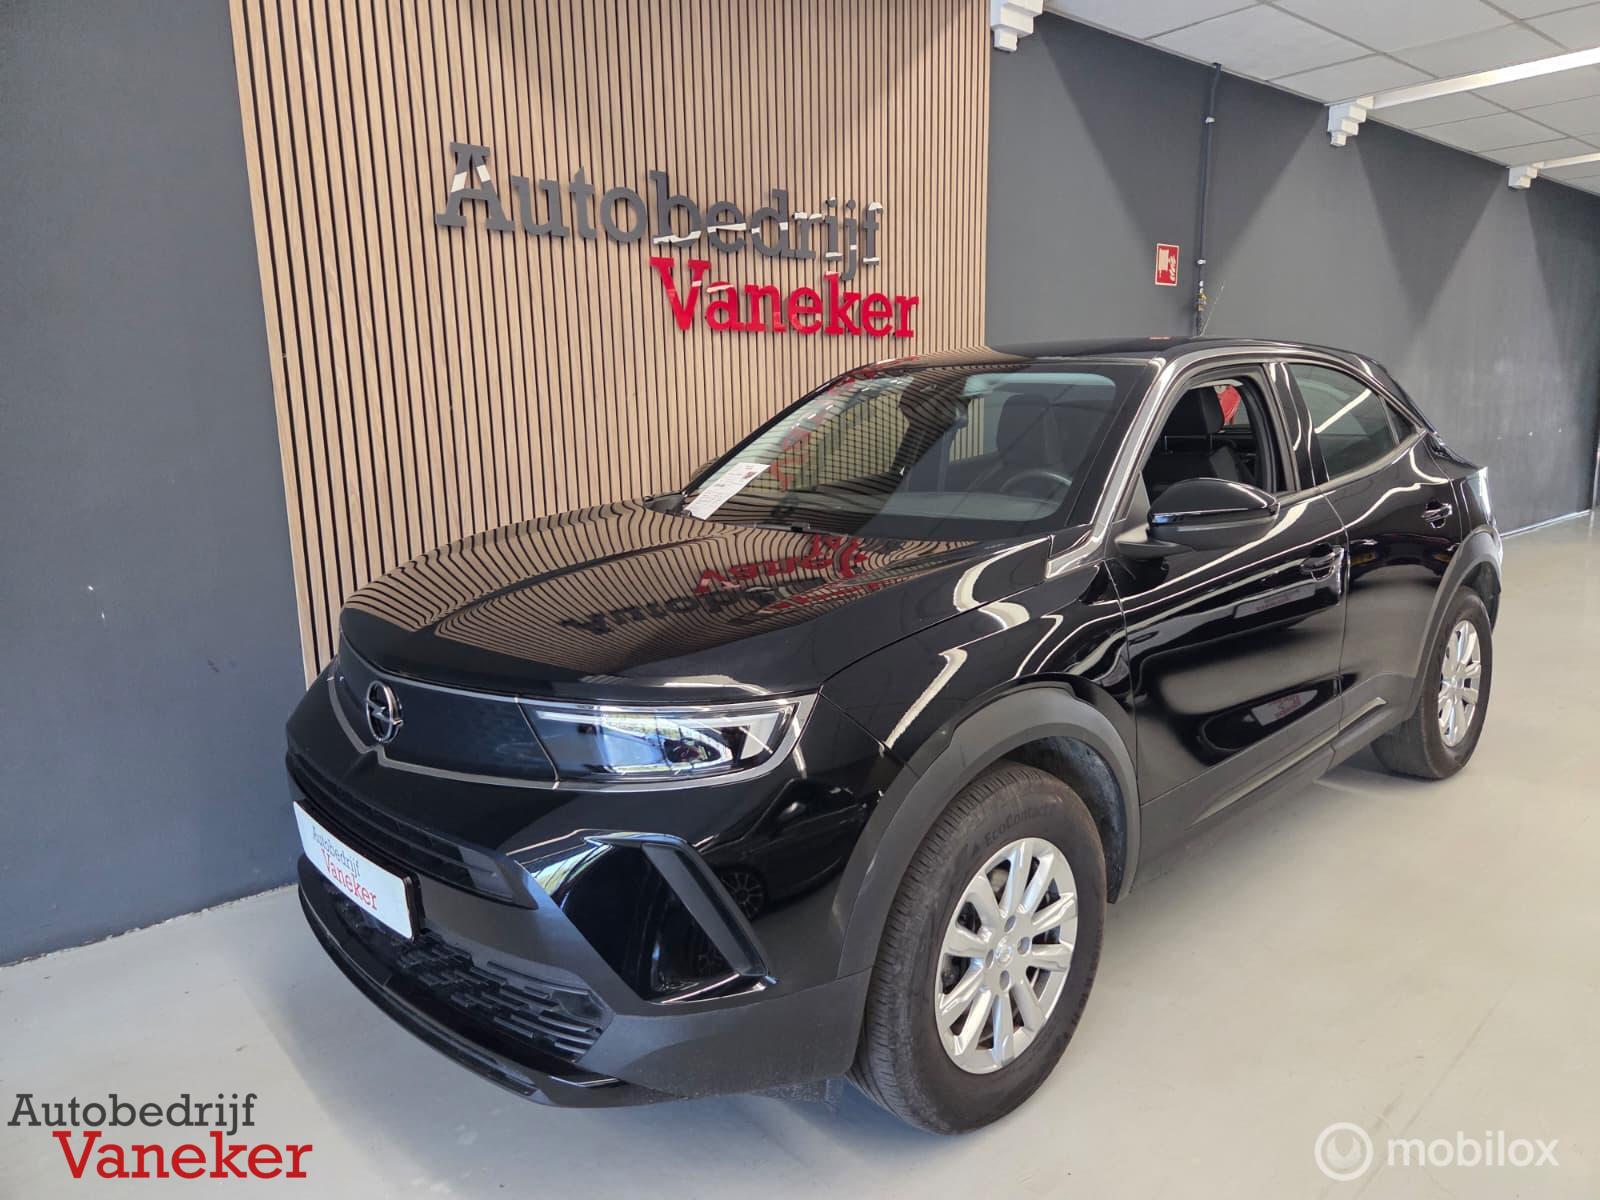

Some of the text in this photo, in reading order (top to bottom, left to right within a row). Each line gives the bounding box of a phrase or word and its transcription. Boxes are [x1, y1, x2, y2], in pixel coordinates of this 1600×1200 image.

[435, 141, 884, 280] Autobedrijf
[649, 256, 919, 338] Vaneker
[312, 826, 361, 879] Autobedrijf
[321, 848, 377, 910] Vaneker
